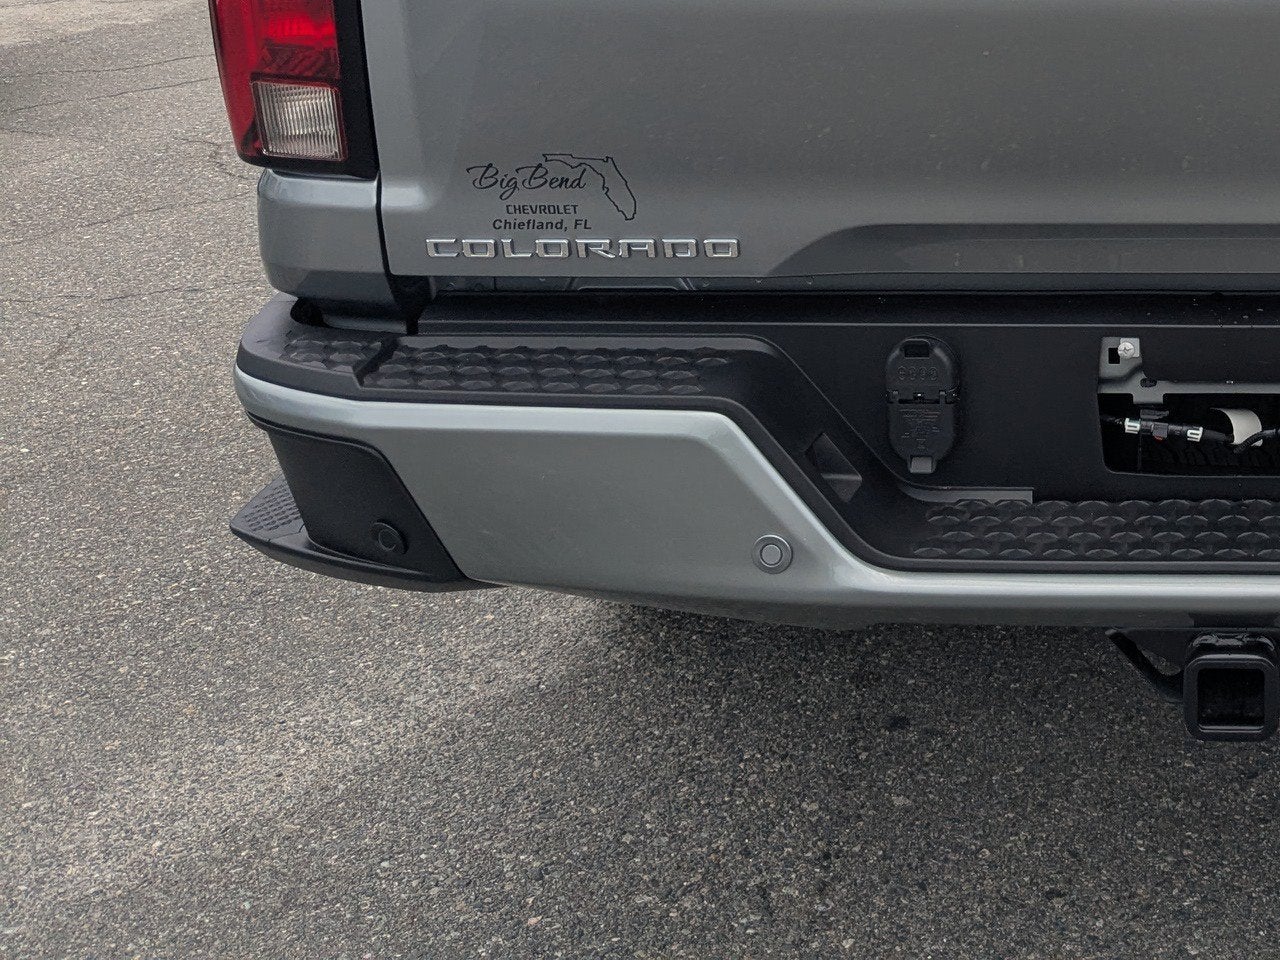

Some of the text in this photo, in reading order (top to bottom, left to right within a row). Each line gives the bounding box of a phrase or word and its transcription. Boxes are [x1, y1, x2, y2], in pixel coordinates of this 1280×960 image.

[466, 163, 587, 201] Big Bend
[505, 204, 579, 215] CHEVROLET
[492, 218, 592, 232] Chiefland, FL
[426, 238, 740, 258] COLORADO
